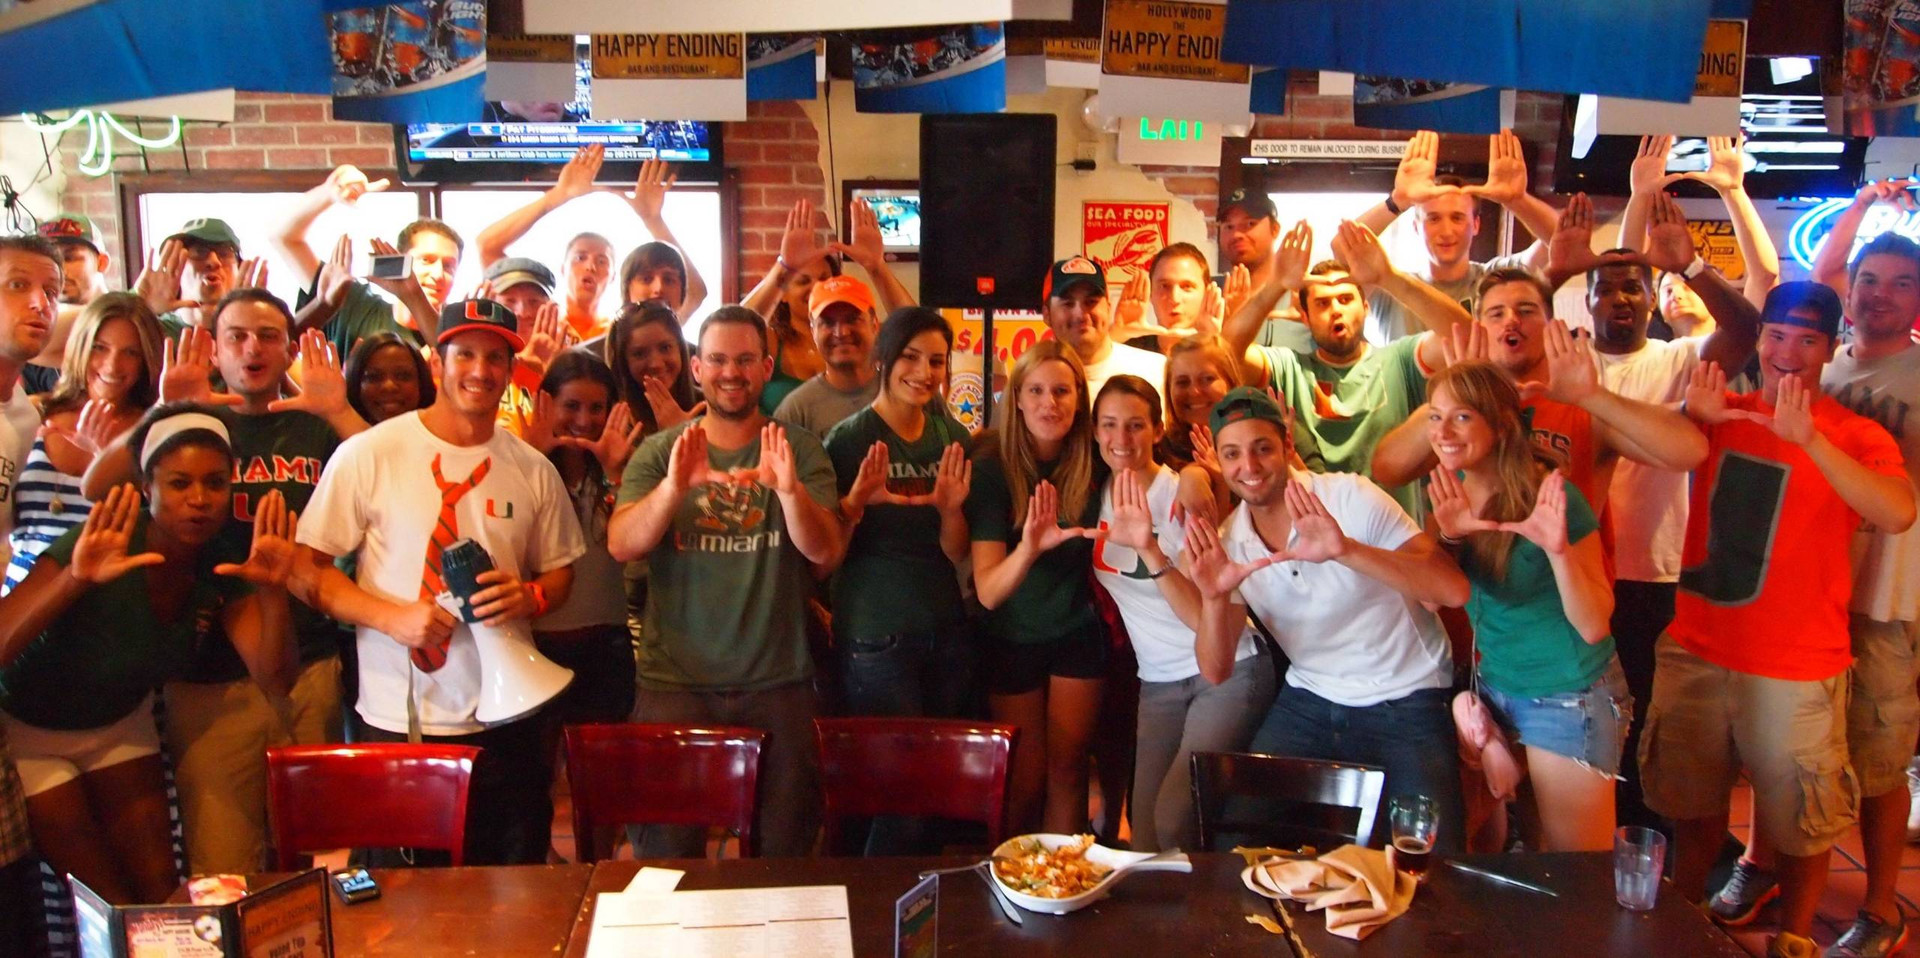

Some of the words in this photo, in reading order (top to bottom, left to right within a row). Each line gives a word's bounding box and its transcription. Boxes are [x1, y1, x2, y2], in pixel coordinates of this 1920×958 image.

[1148, 4, 1212, 21] HOLLYWOOD
[596, 33, 659, 58] HAPPY
[666, 33, 738, 59] ENDING
[1108, 30, 1172, 58] HAPPY
[1178, 35, 1220, 61] ENDI
[643, 63, 661, 75] AND
[662, 63, 709, 75] RESTAURANT
[1153, 64, 1168, 74] AND
[1171, 65, 1216, 77] RESTAURANT
[1270, 143, 1288, 154] DOOR
[1290, 143, 1299, 154] TO
[1301, 143, 1322, 155] REMAIN
[1323, 143, 1356, 155] UNLOCKED
[1357, 144, 1380, 155] DURING
[1123, 208, 1166, 222] FOOD
[465, 300, 504, 323] U
[486, 498, 514, 519] U
